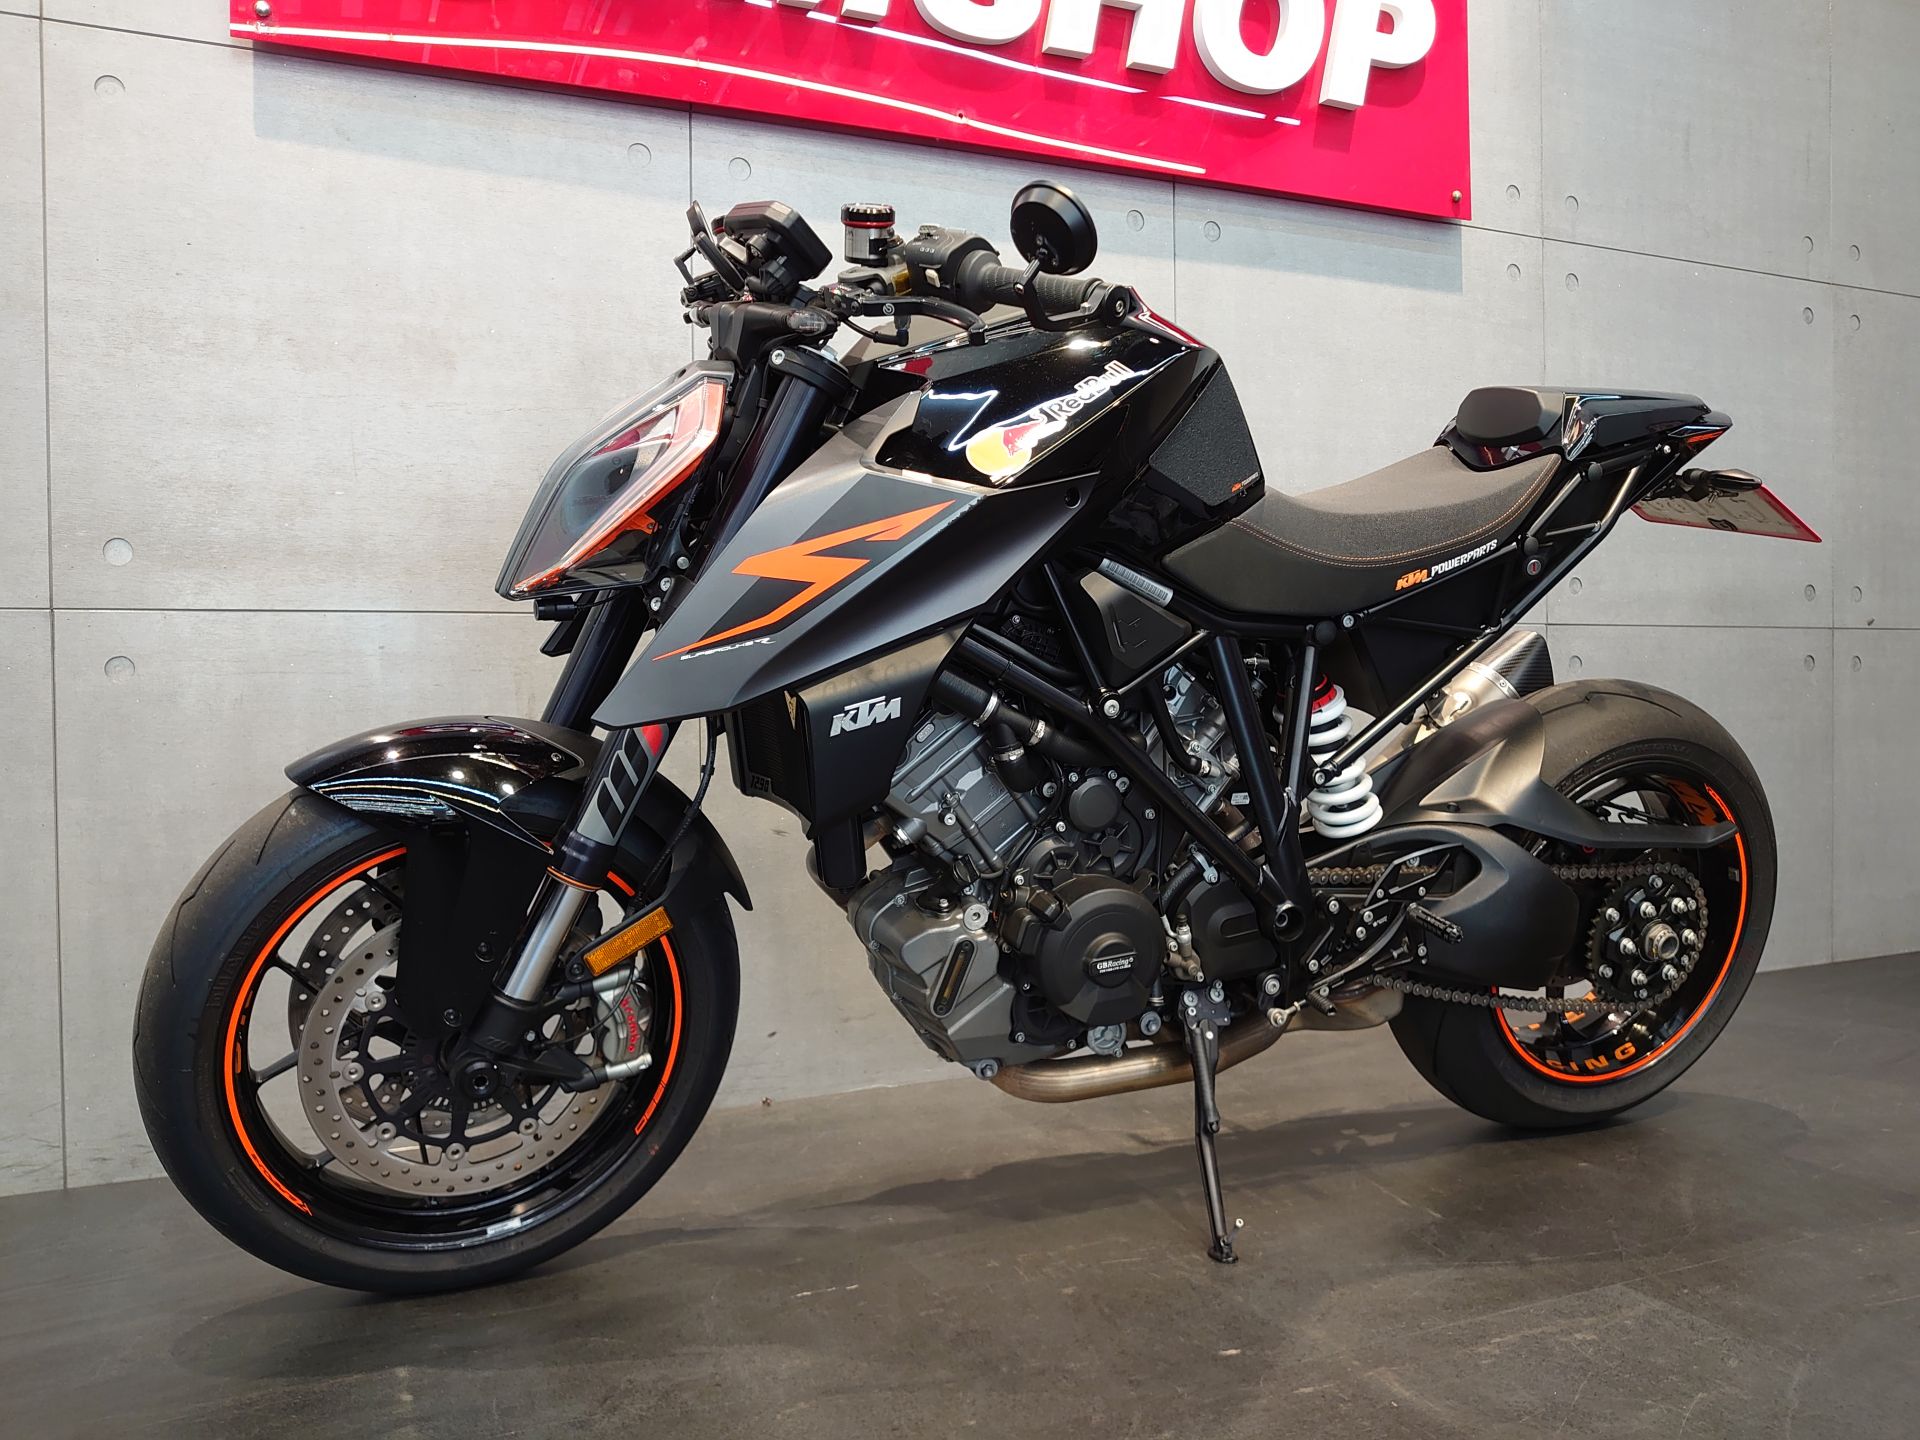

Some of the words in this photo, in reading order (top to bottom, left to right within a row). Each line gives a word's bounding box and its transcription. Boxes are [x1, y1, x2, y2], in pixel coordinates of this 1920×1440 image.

[1395, 568, 1429, 591] KTM
[1430, 539, 1498, 577] POWERPARTS
[829, 695, 902, 738] KTM
